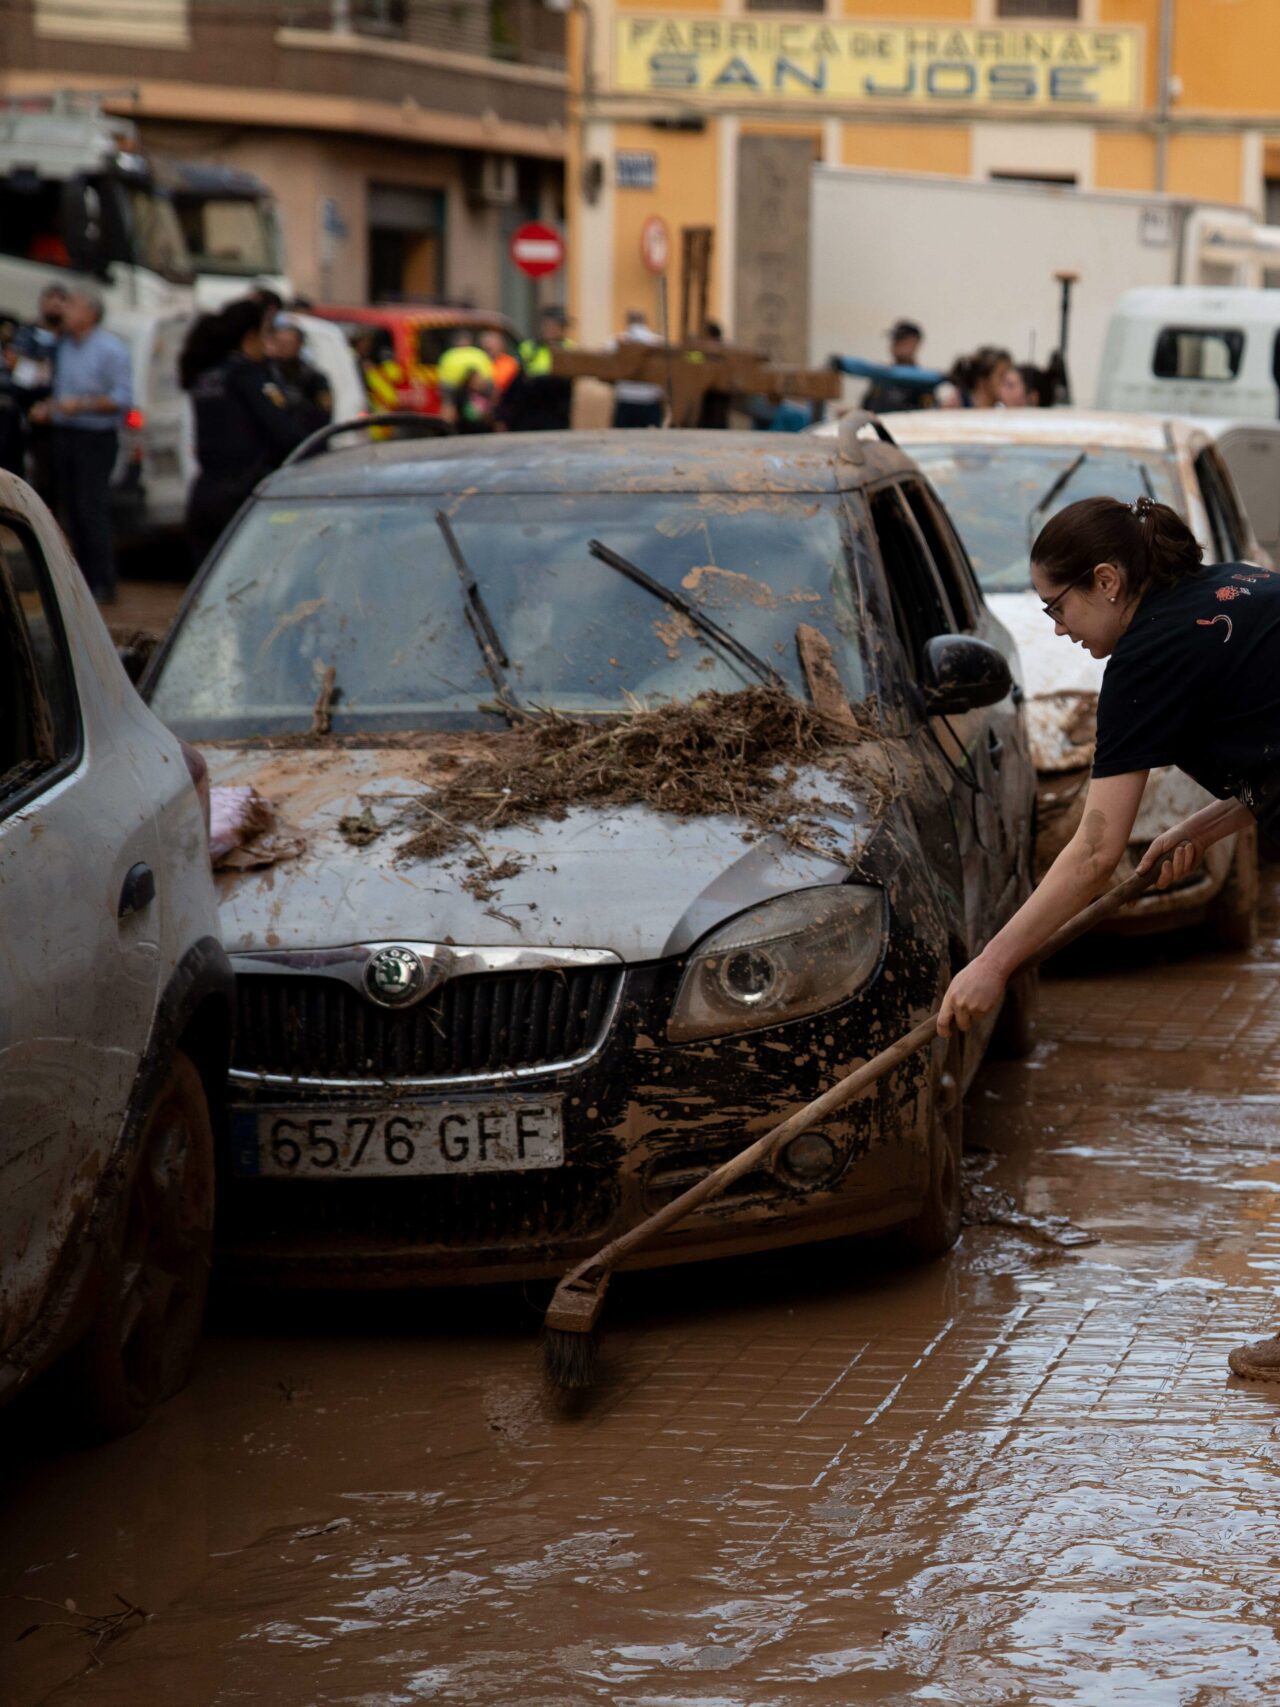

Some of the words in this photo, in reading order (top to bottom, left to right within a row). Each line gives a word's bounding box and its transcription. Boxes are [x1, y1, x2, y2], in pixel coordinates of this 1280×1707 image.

[628, 18, 840, 54] FABRICA
[851, 31, 893, 59] DE
[904, 27, 1120, 64] HARINAS
[649, 52, 826, 90] SAN
[864, 60, 1099, 102] JOSE
[270, 1114, 415, 1168] 6576
[438, 1107, 545, 1162] GFF
